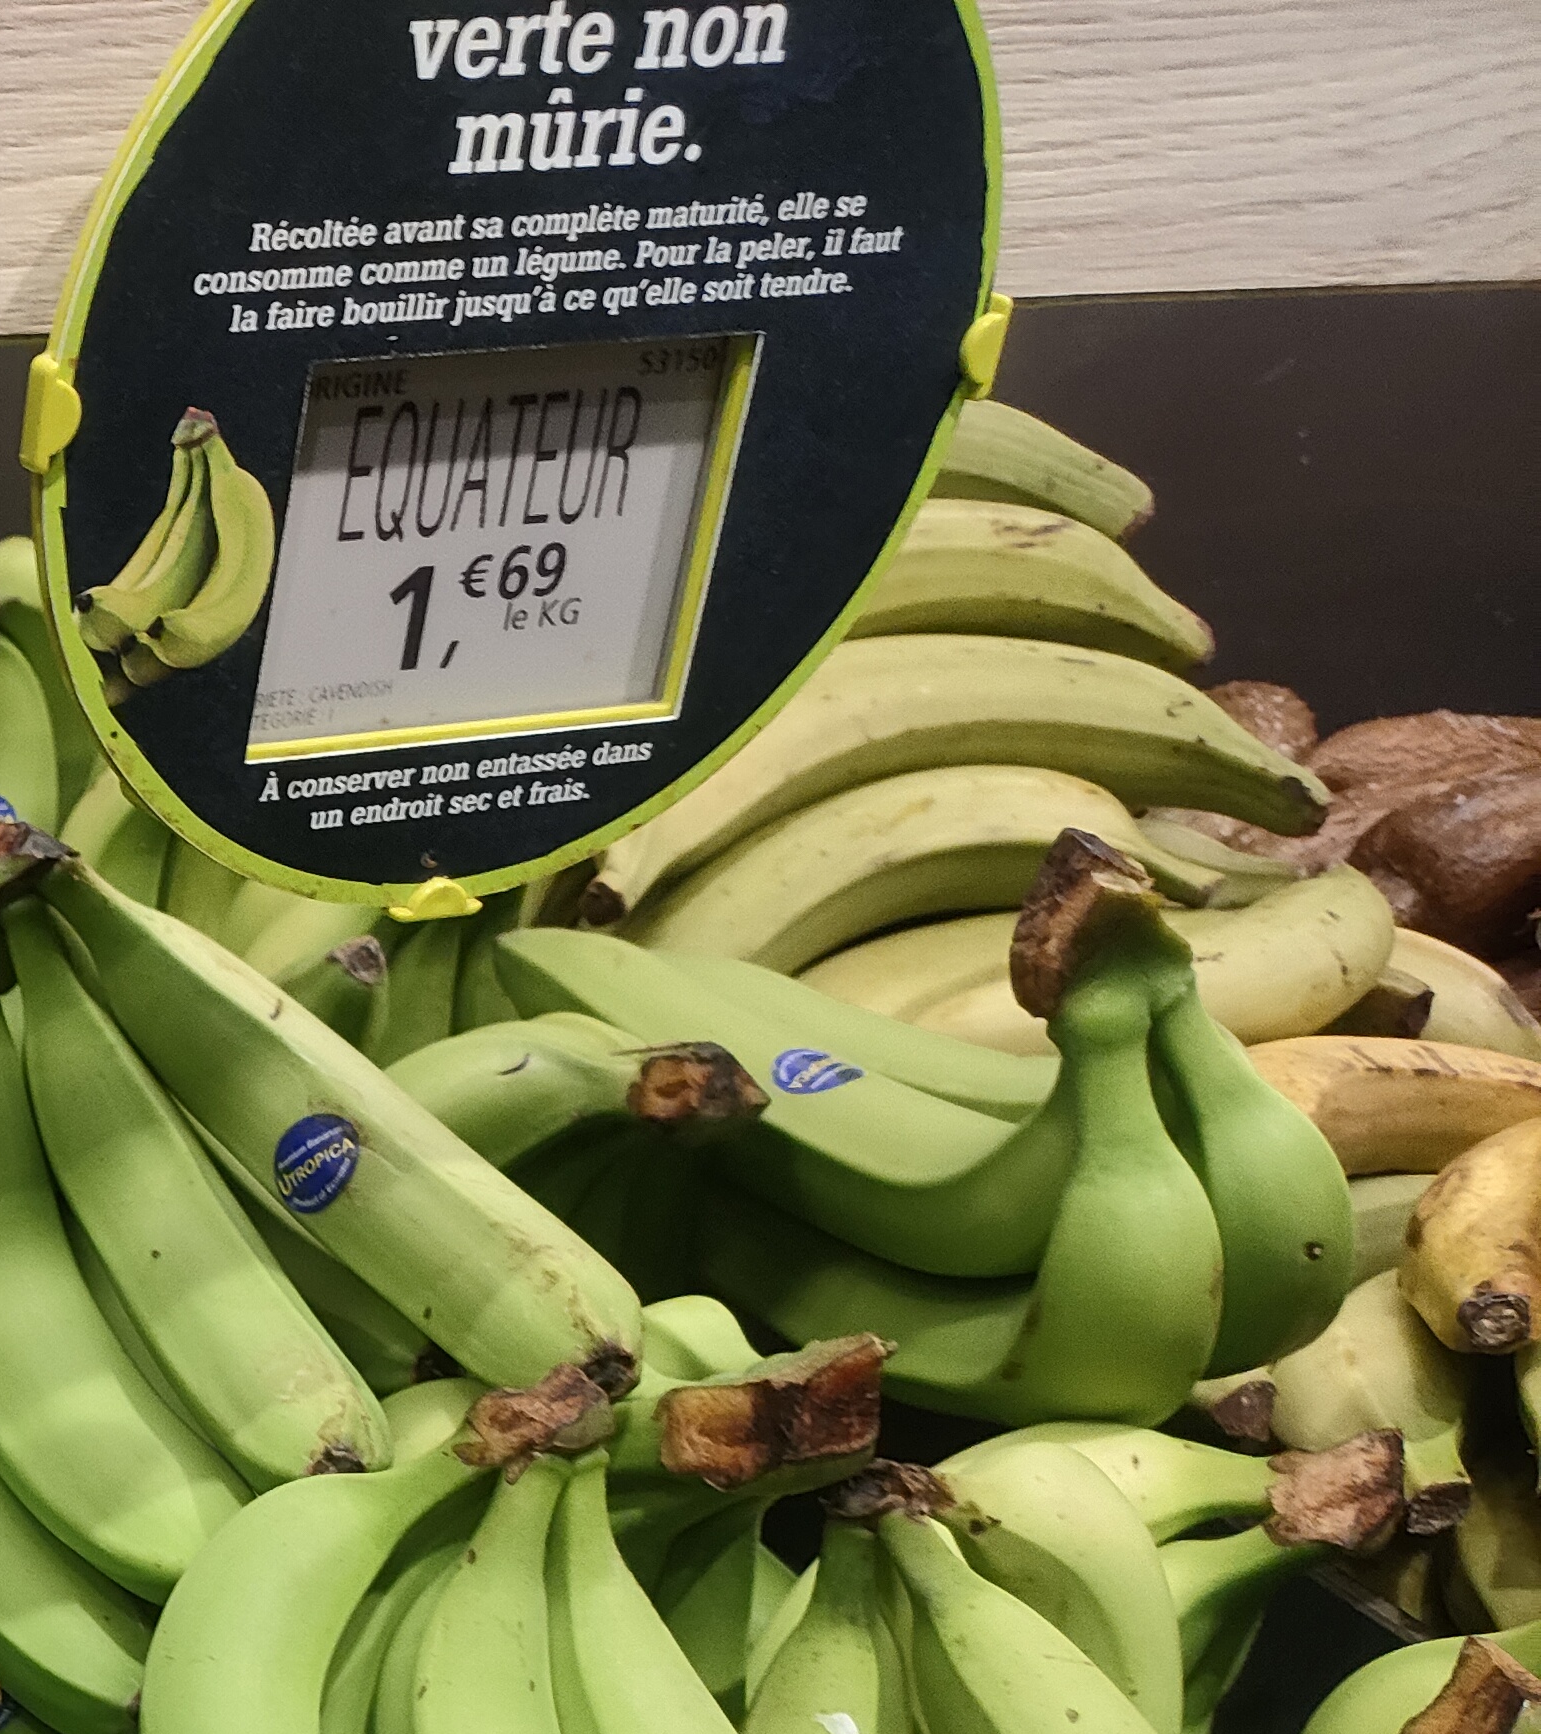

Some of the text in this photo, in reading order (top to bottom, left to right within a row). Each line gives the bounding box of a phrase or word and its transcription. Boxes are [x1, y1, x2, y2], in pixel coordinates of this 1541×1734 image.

[407, 0, 787, 80] verte non
[447, 86, 703, 176] mûrie.
[249, 193, 869, 254] Récoltée avant sa complète maturité, elle se
[192, 225, 903, 296] consomme comme un légume. Pour la peler, il faut
[228, 303, 260, 335] la
[264, 298, 337, 335] faire
[340, 290, 449, 329] bouillir
[563, 285, 598, 312] ce
[602, 275, 698, 317] qu'elle
[702, 272, 755, 303] soit
[759, 270, 854, 298] tendre.
[310, 368, 410, 400] RIGINE
[338, 386, 641, 543] EQUATEUR
[503, 597, 581, 632] le KG
[260, 738, 653, 802] À conserver non entassée dans
[310, 779, 591, 830] un endroit sec et frais.
[278, 1138, 355, 1197] UTROPICA
